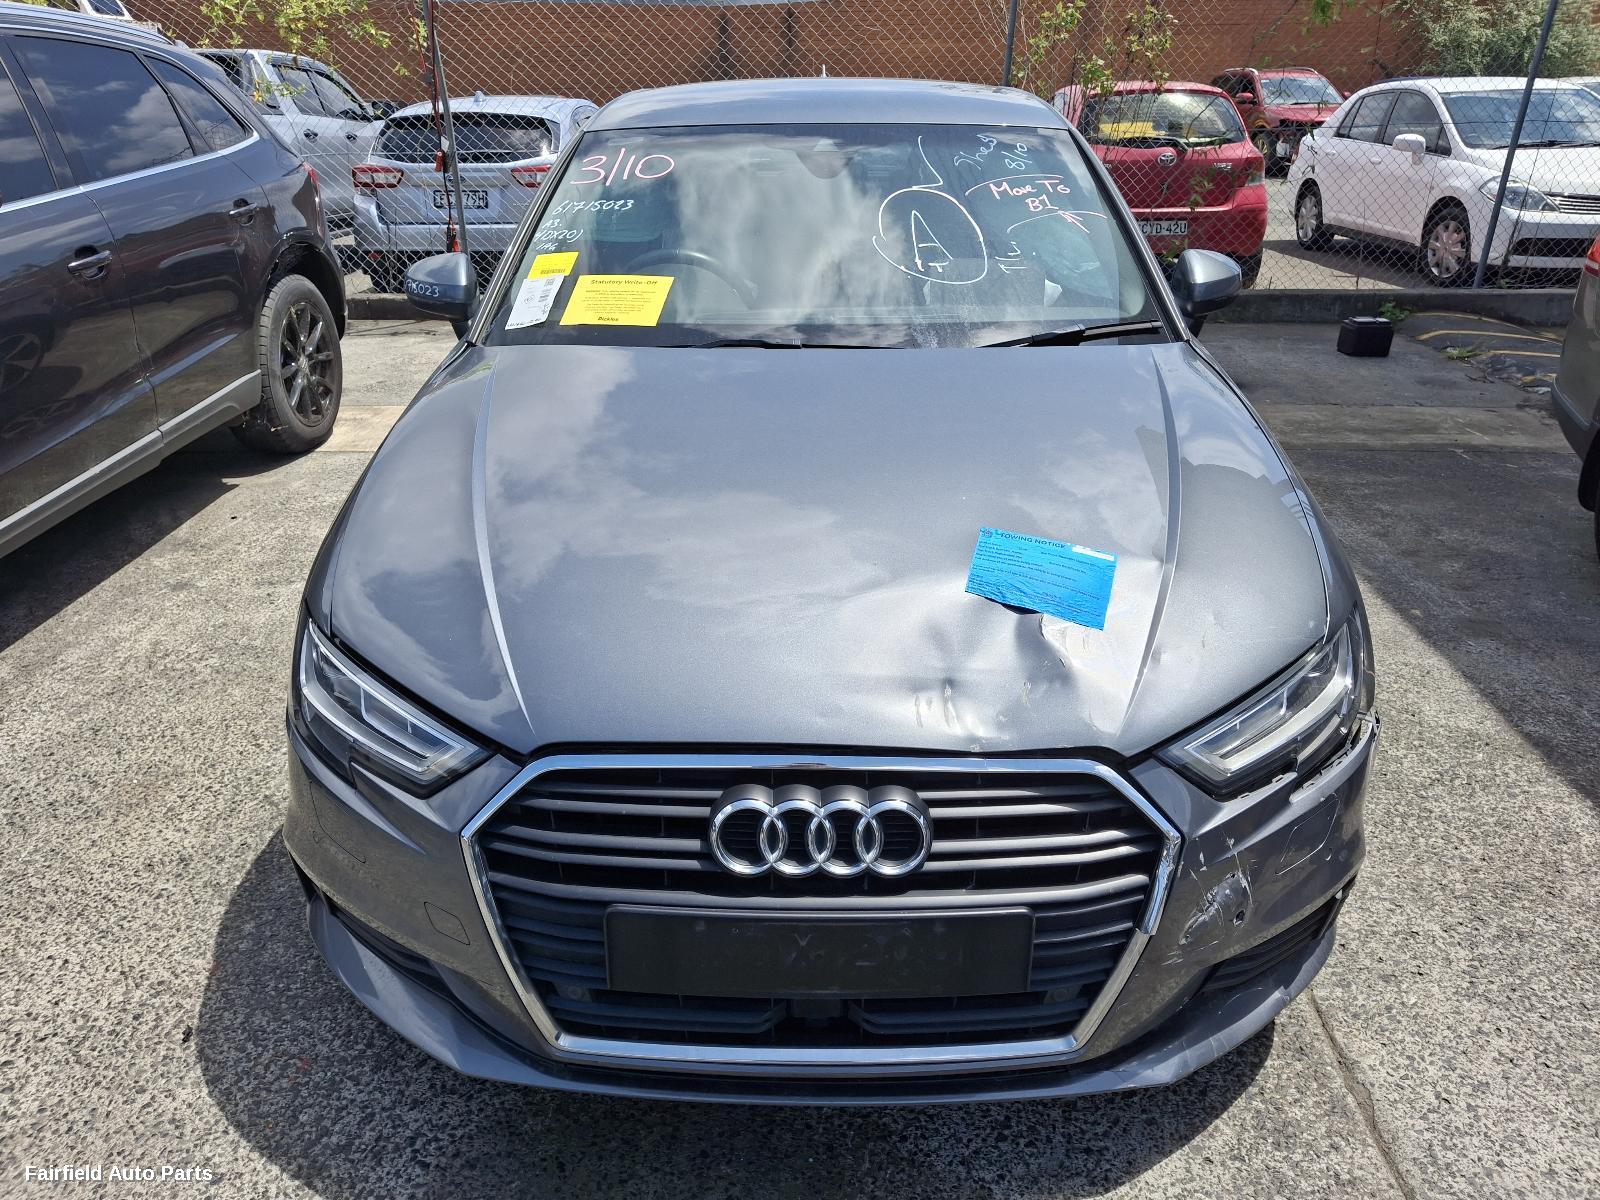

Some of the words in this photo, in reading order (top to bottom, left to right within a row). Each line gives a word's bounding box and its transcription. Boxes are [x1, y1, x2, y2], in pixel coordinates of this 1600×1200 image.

[570, 148, 675, 186] 3/10
[552, 199, 635, 215] 61715023
[1000, 531, 1033, 543] TOWING
